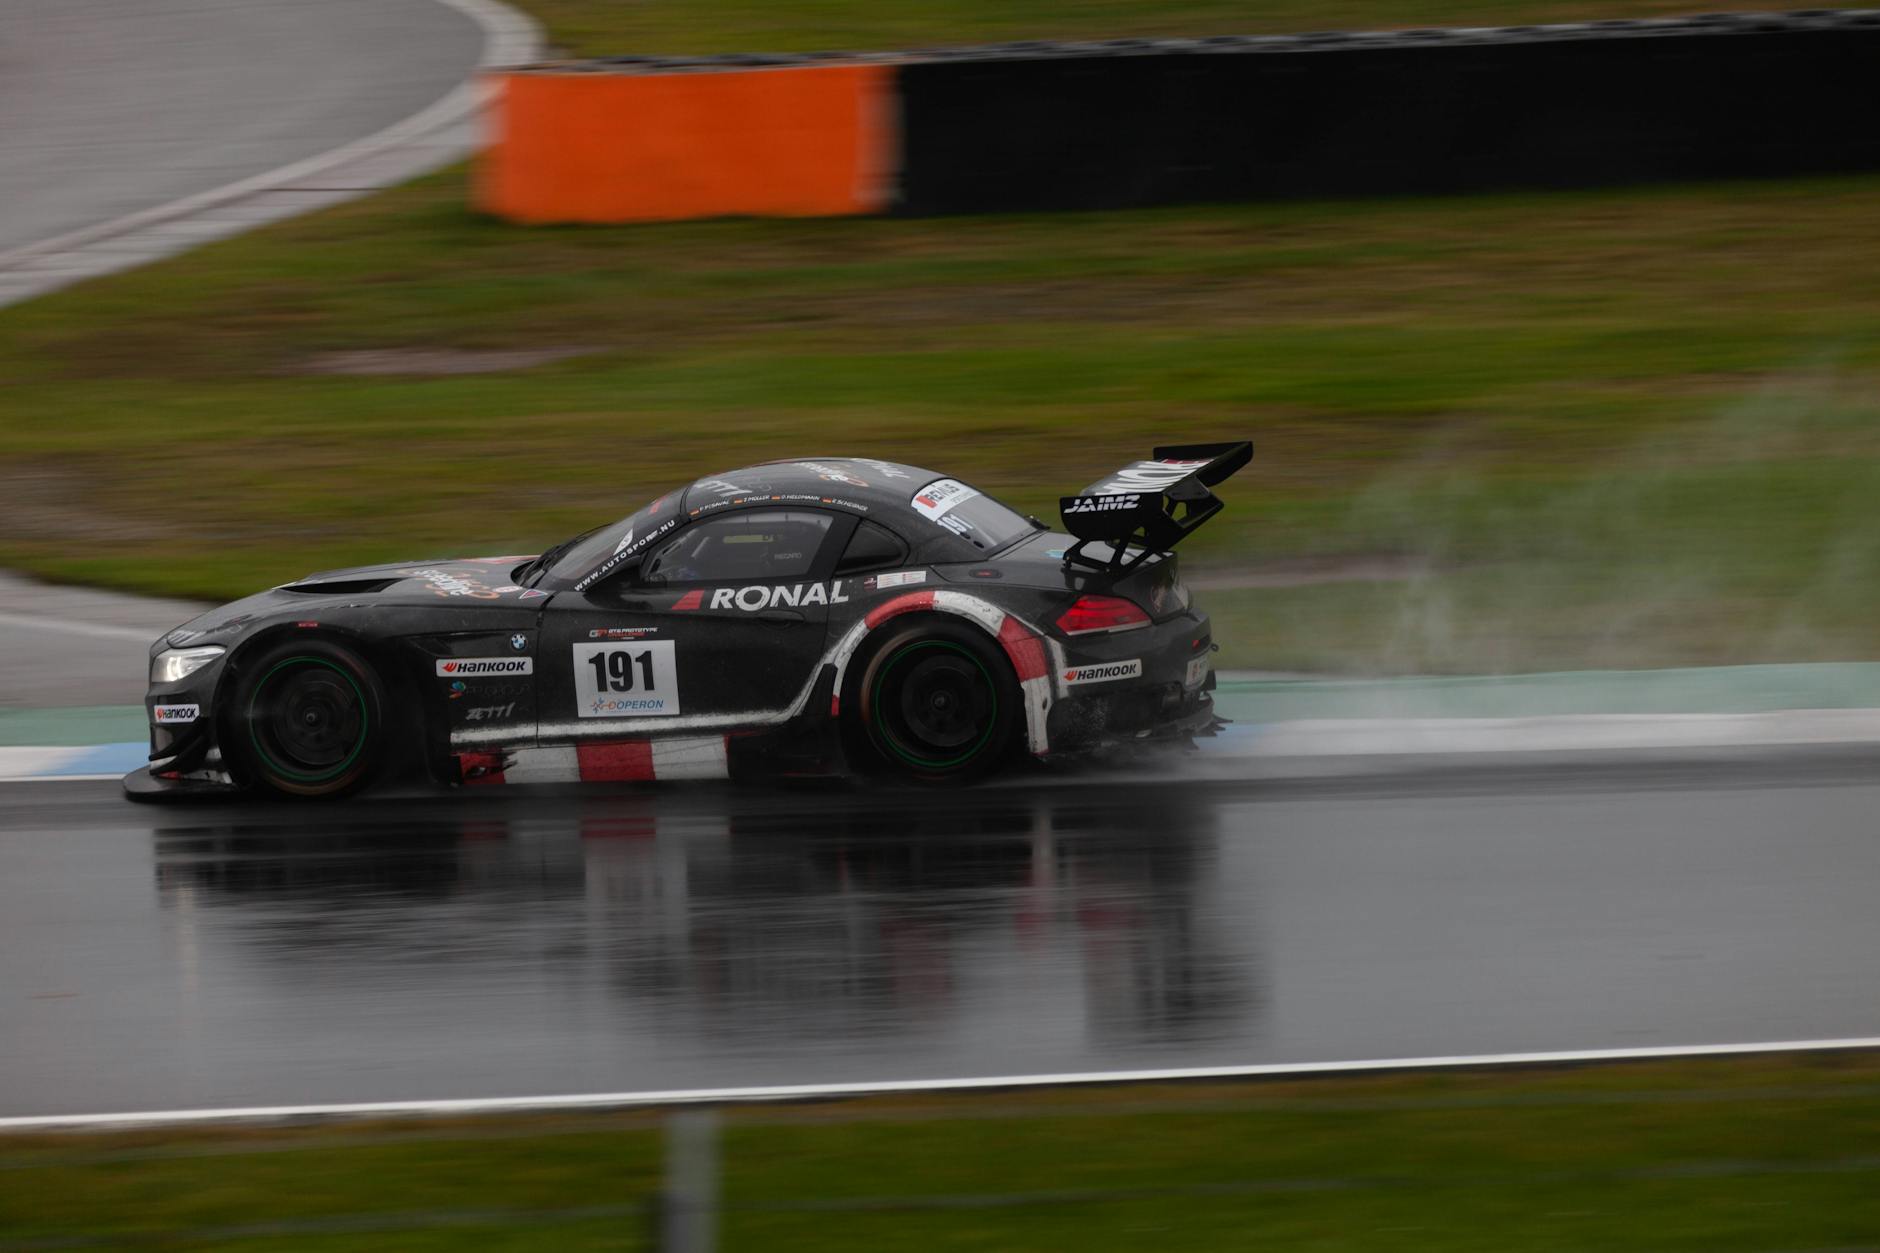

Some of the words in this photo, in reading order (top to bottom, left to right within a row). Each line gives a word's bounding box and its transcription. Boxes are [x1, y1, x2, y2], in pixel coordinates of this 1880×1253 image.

[1063, 494, 1141, 514] JAIMZ
[936, 513, 975, 536] 191
[710, 580, 849, 611] RONAL
[457, 661, 526, 673] HANKOOK
[588, 650, 655, 693] 191
[1077, 663, 1137, 681] HANKOOK
